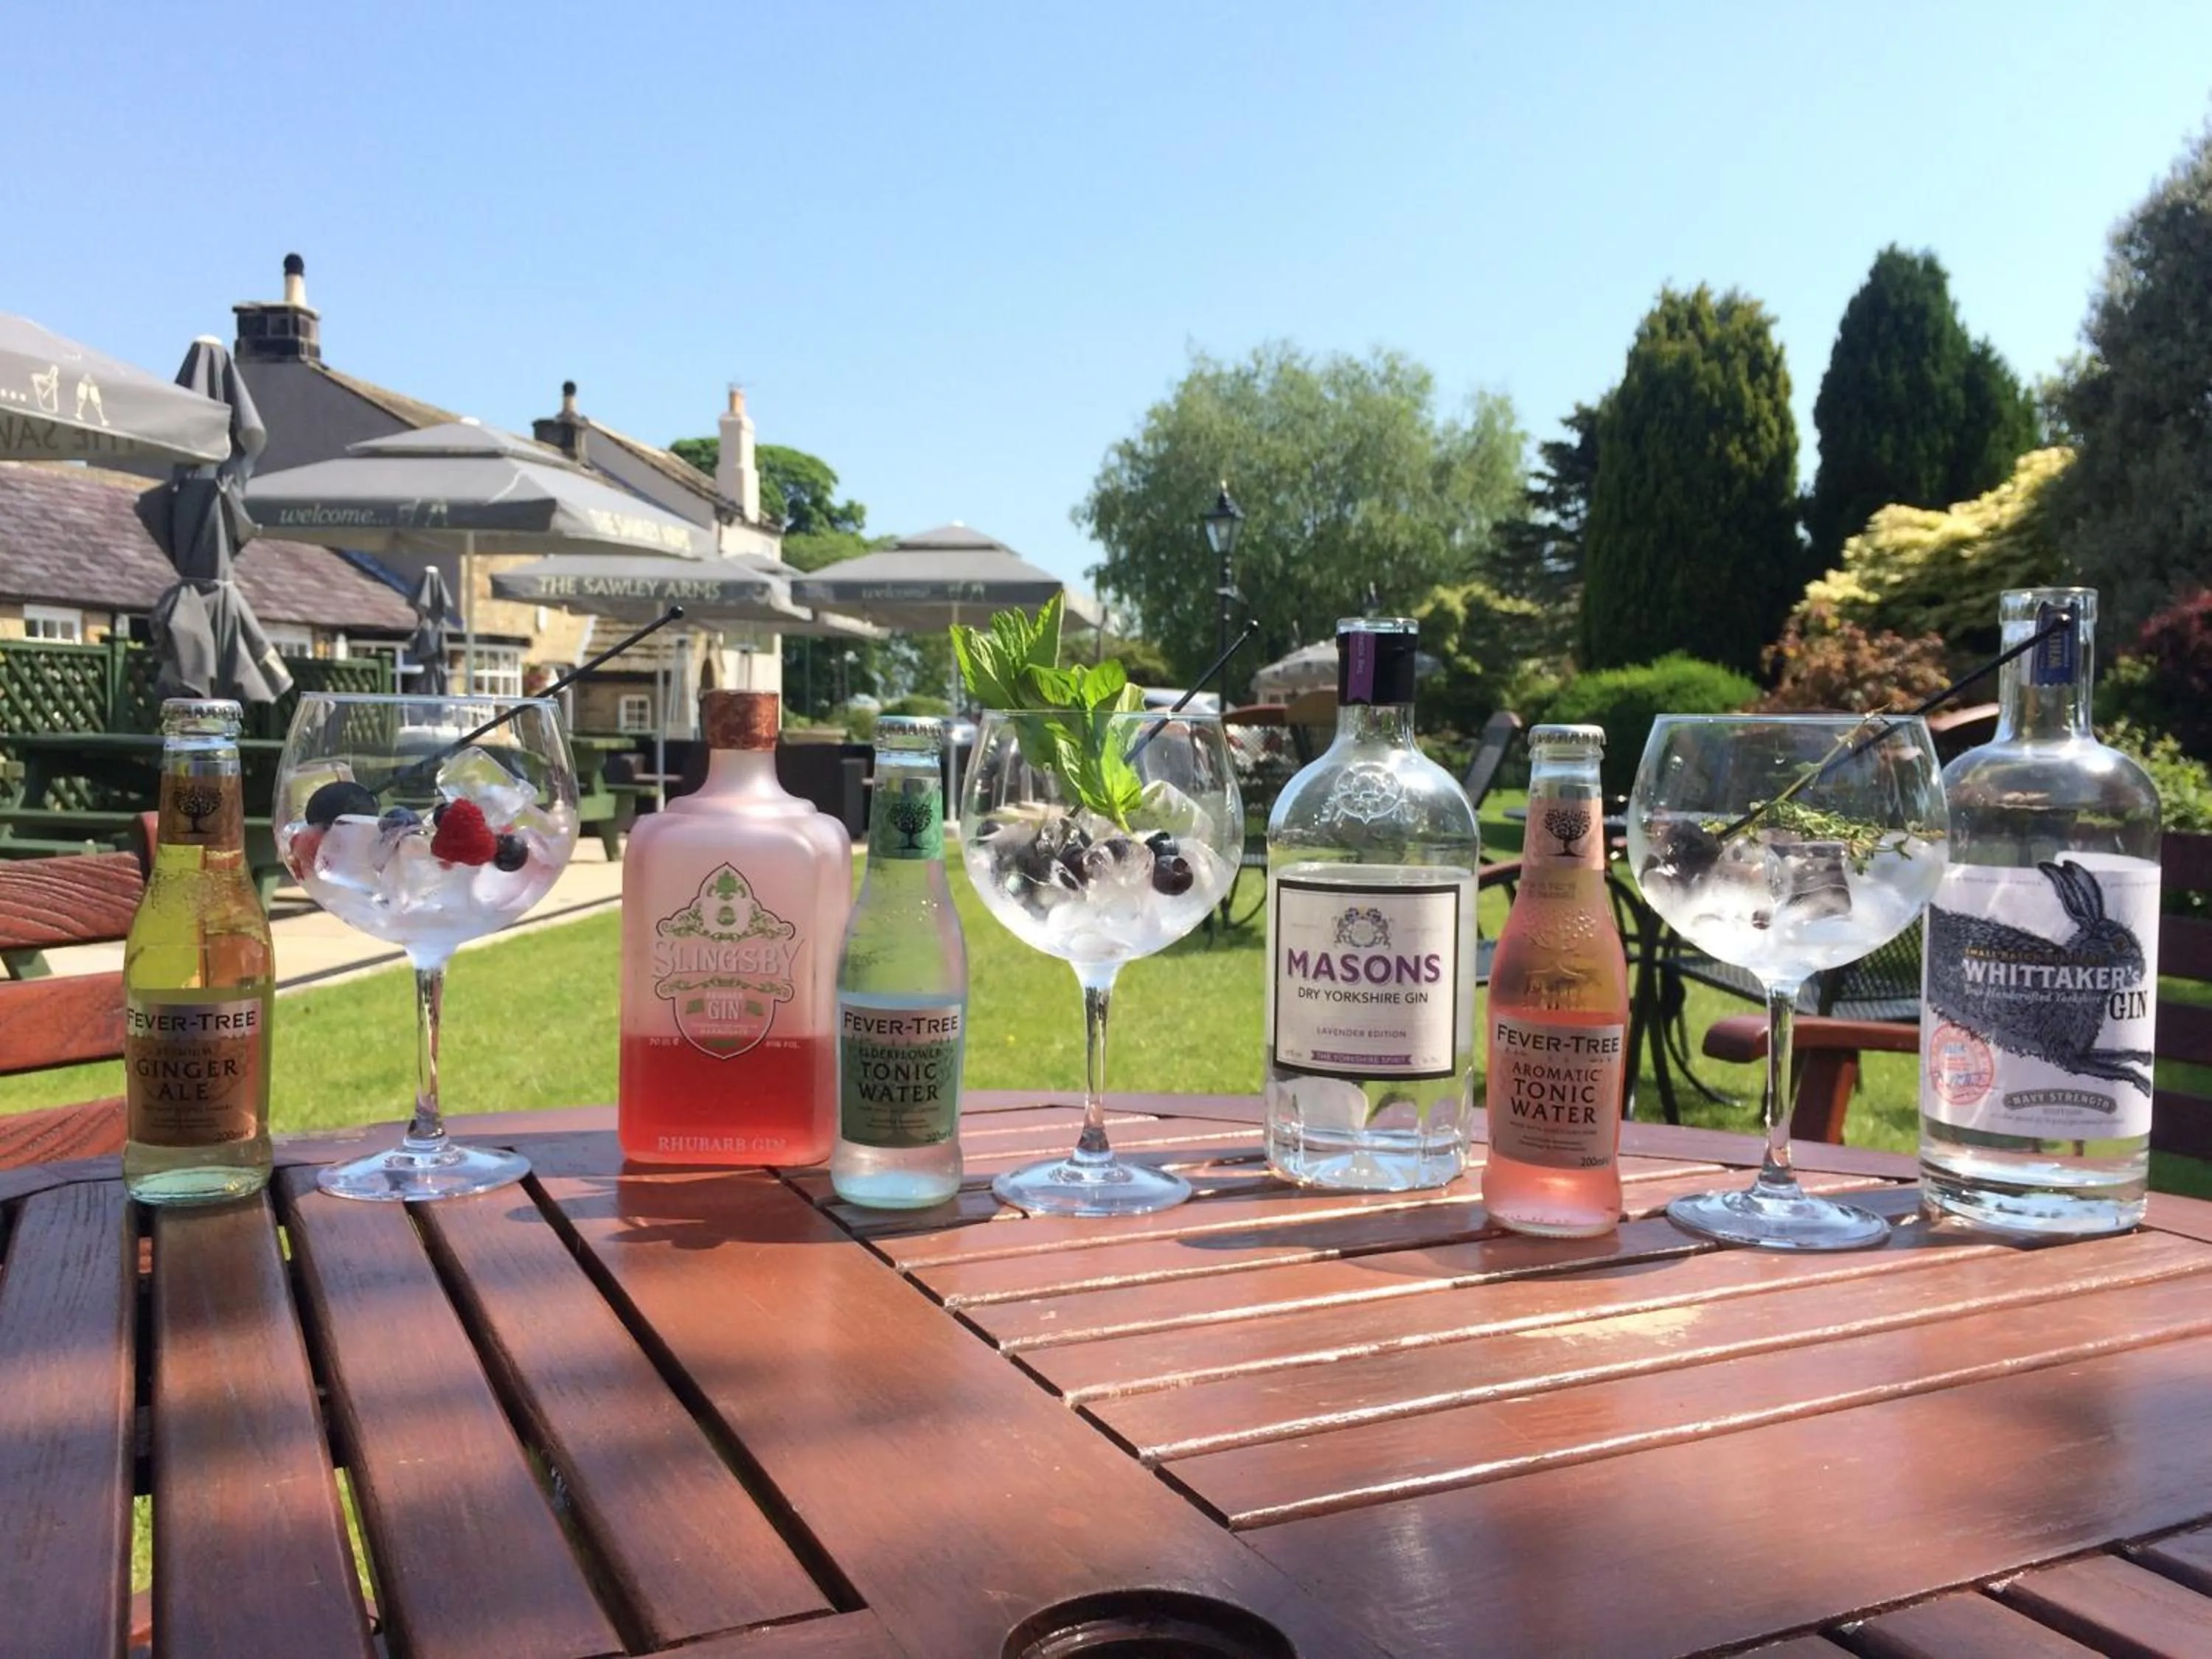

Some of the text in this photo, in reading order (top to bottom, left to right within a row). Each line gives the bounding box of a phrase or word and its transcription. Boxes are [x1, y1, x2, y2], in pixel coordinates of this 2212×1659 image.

[538, 575, 721, 599] THE SAWLEY ARMS
[652, 938, 805, 983] SLINGSBY
[1287, 947, 1441, 984] MASONS
[1298, 987, 1428, 1004] DRY YORKSHIRE GIN
[2109, 990, 2147, 1020] GIN
[126, 1007, 257, 1031] FEVER-TREE
[708, 999, 740, 1020] GIN
[844, 1011, 959, 1035] FEVER-TREE
[1316, 1026, 1407, 1038] LAVENDER EDITION
[1498, 1023, 1620, 1054] FEVER-TREE
[136, 1058, 238, 1079] GINGER
[860, 1061, 937, 1081] TONIC
[1512, 1061, 1603, 1082] AROMATIC
[158, 1082, 209, 1101] ALE
[858, 1082, 939, 1102] WATER
[1513, 1078, 1596, 1103] TONIC
[1510, 1096, 1596, 1124] WATER
[657, 1135, 746, 1152] RHUBARB
